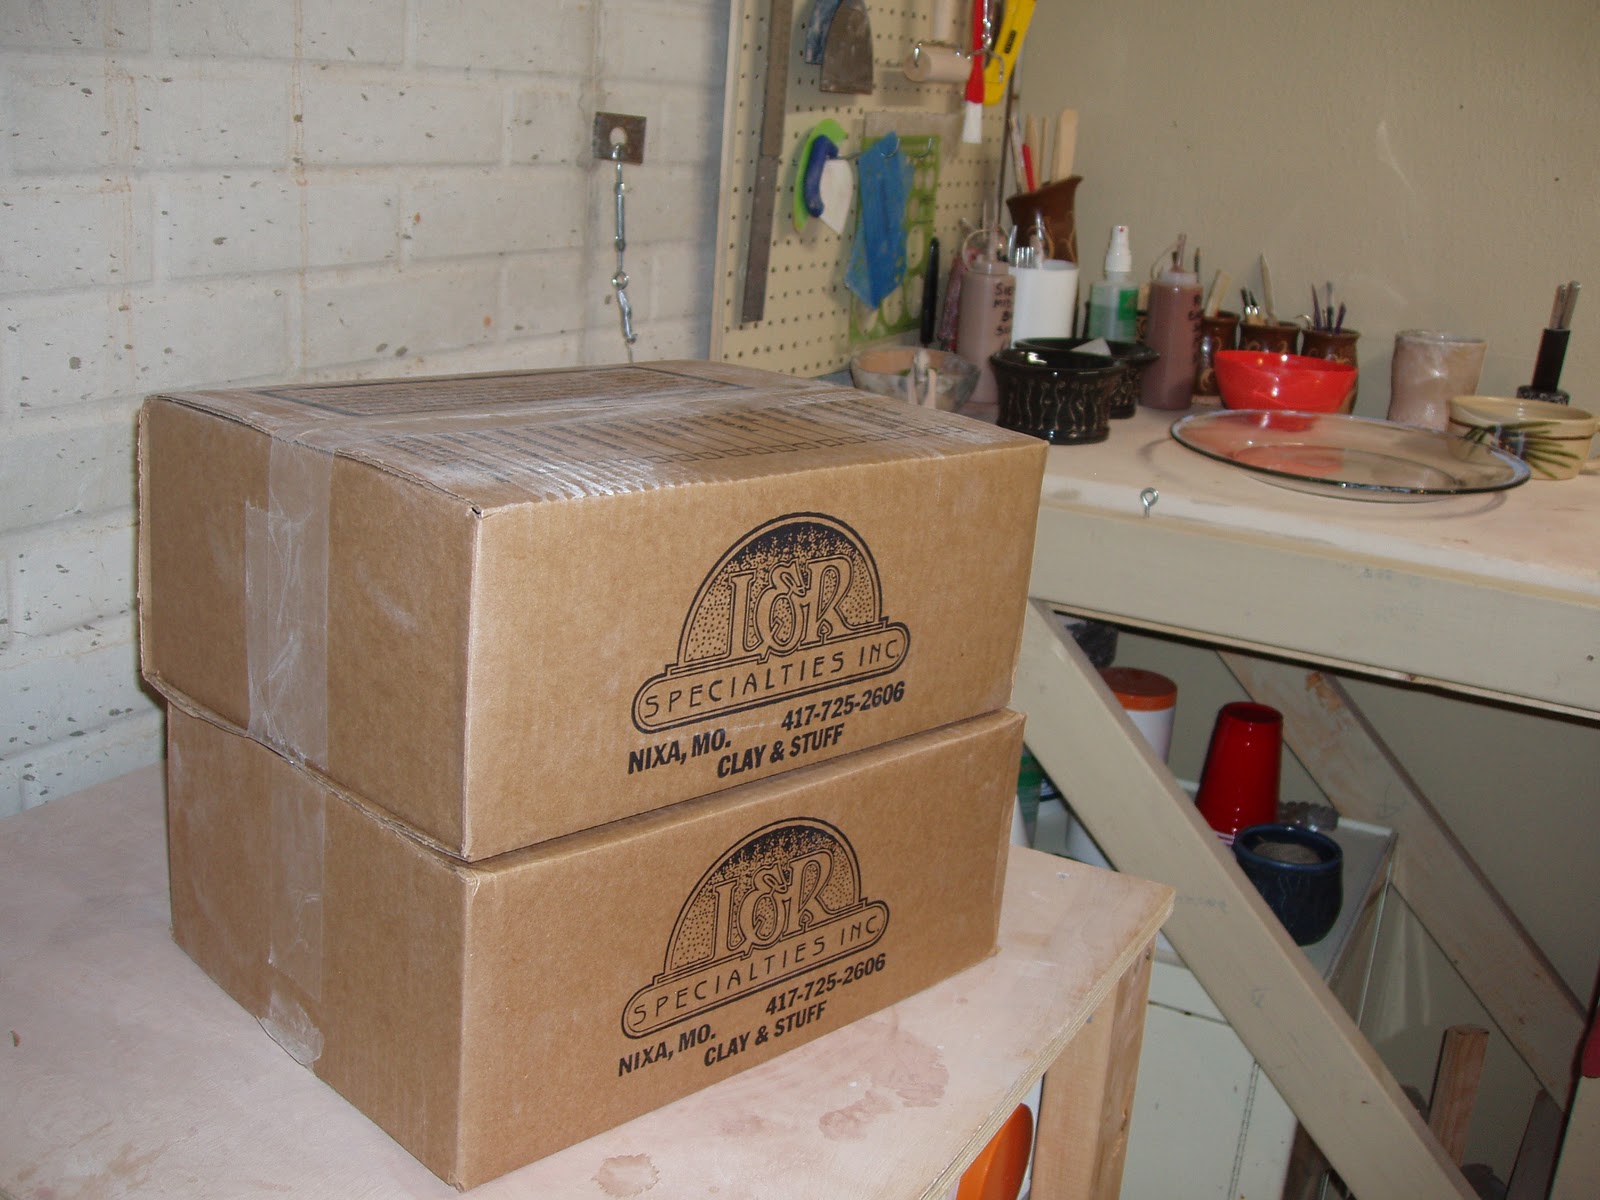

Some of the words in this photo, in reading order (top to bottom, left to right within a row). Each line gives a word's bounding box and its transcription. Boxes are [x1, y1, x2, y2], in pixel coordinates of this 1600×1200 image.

[643, 652, 844, 719] SPECIALTIES
[781, 680, 905, 731] 417-725-2606
[627, 739, 686, 775] NIXA,
[691, 727, 732, 757] MO.
[717, 745, 765, 778] CLAY
[769, 739, 785, 764] &
[789, 723, 844, 757] STUFF
[632, 936, 826, 1027] SPECIALTIES
[765, 952, 886, 1016] 417-725-2606
[617, 1041, 674, 1077] NIXA,
[677, 1022, 716, 1052] MO.
[703, 1036, 751, 1067] CLAY
[754, 1025, 769, 1046] &
[774, 1001, 828, 1038] STUFF
